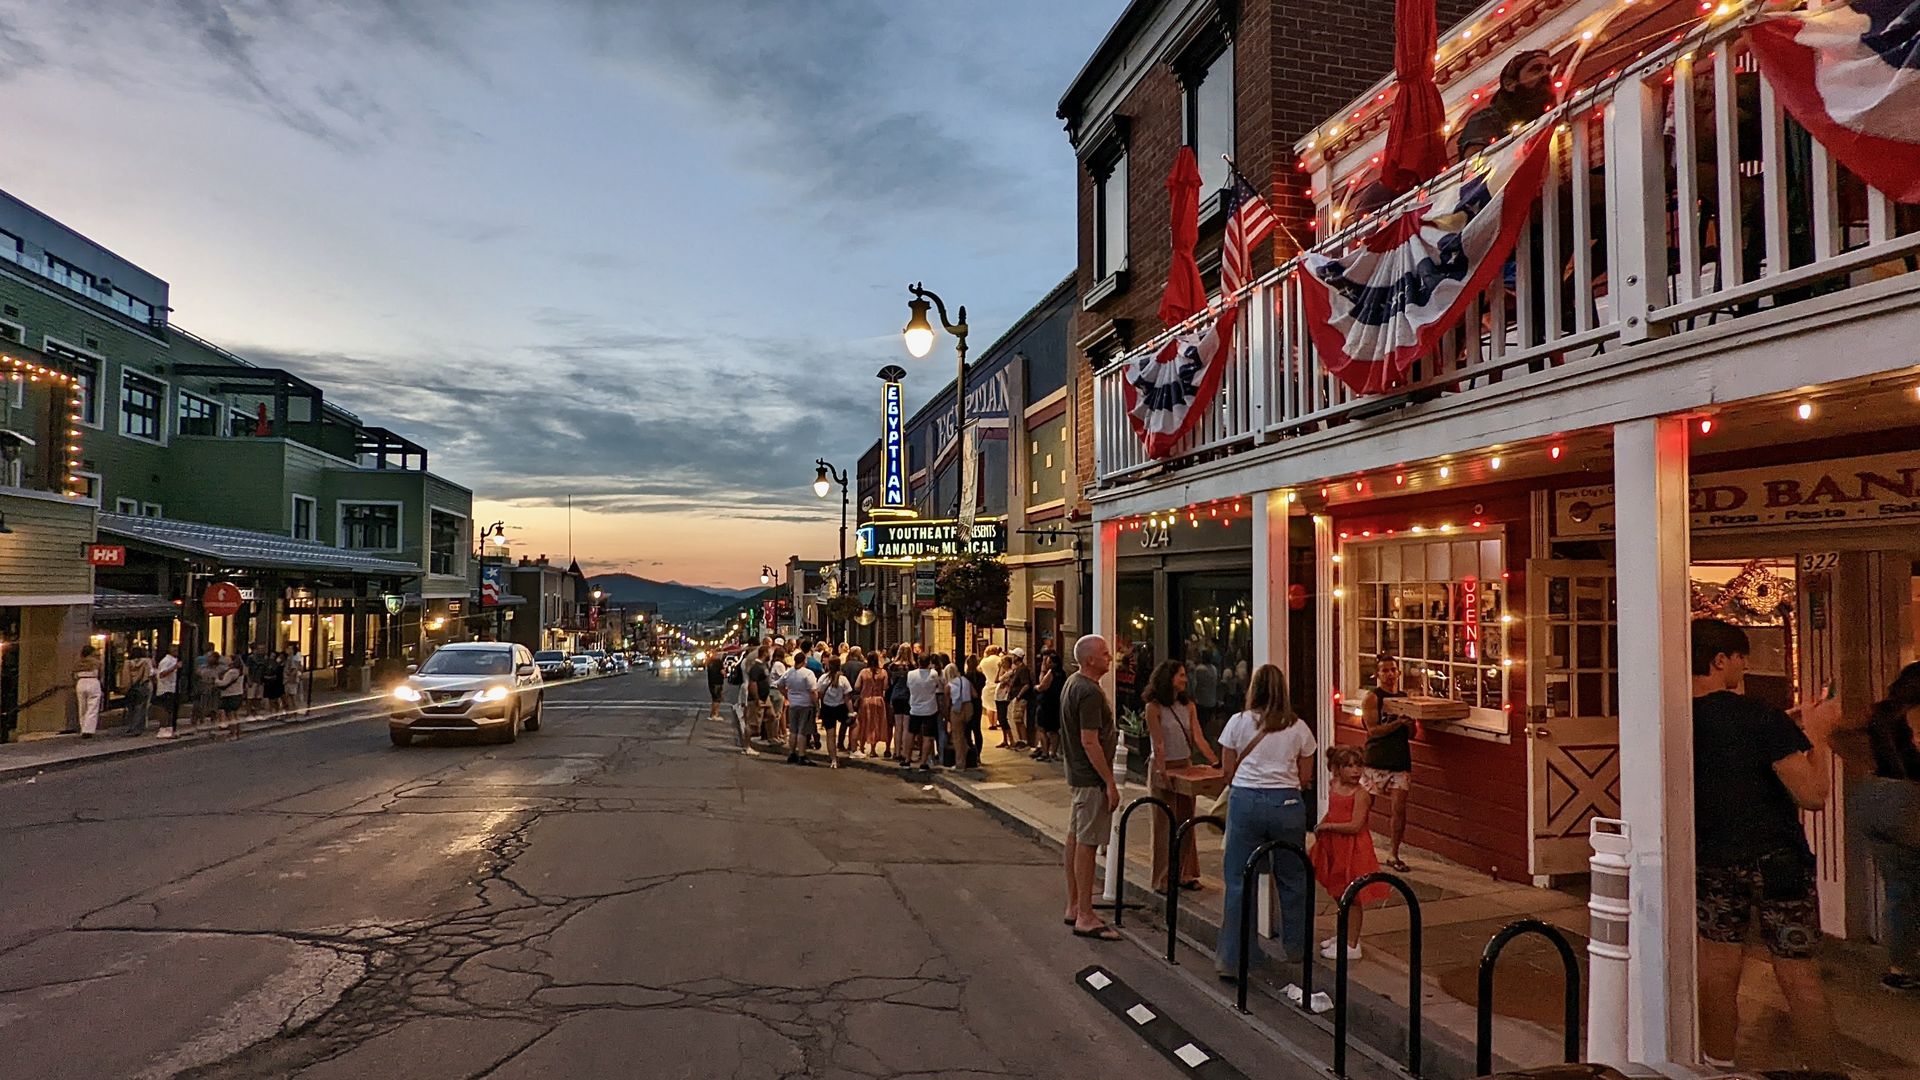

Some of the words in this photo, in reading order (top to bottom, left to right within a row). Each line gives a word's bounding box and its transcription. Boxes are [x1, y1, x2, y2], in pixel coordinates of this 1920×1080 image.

[887, 386, 901, 504] EGYPTIAN
[1763, 467, 1920, 508] BAN
[1709, 514, 1759, 525] Pizza
[1785, 508, 1847, 521] Pasta
[1140, 521, 1169, 548] 324
[93, 549, 118, 561] HH
[877, 542, 924, 556] XANADU
[926, 544, 940, 553] THE
[1803, 552, 1838, 571] 322
[1464, 577, 1478, 640] OPEN
